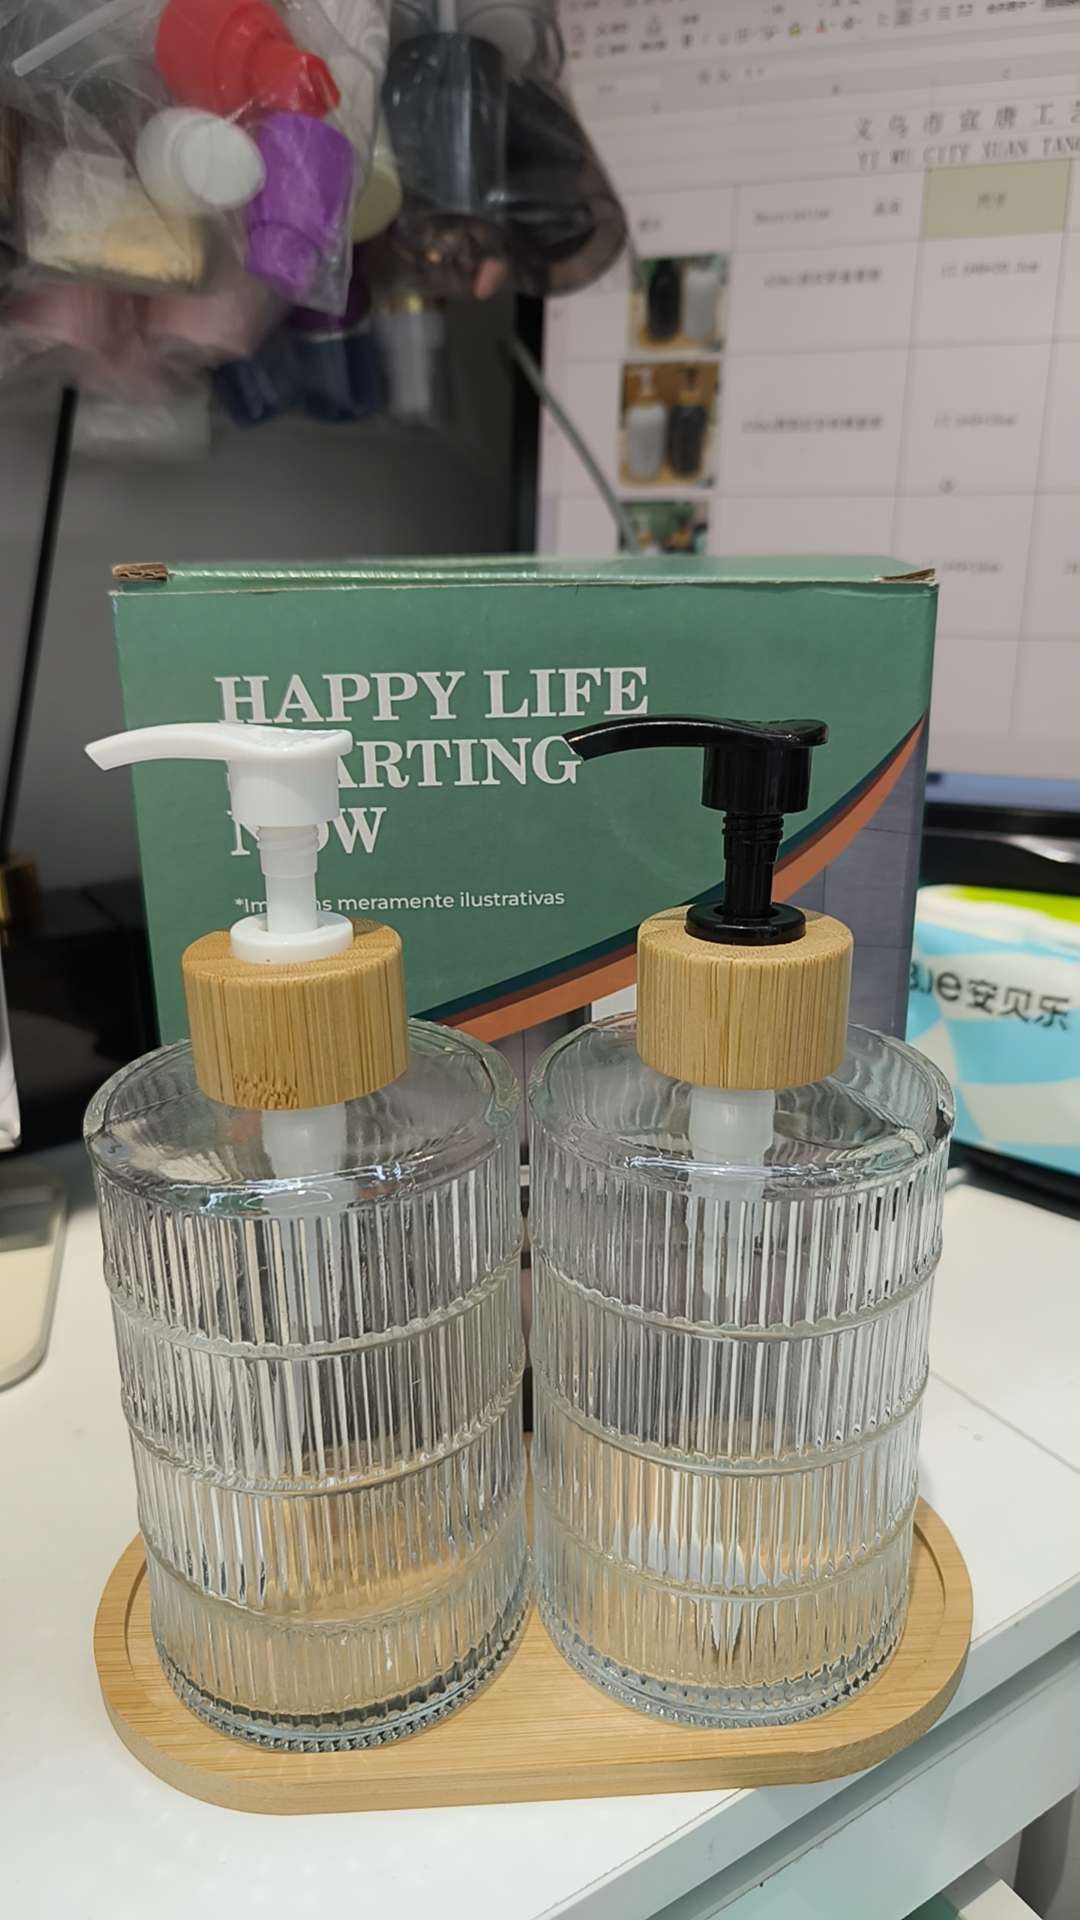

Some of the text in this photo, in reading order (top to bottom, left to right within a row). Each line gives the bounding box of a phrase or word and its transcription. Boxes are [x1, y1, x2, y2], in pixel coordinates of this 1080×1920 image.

[214, 666, 649, 725] HAPPY LIFE
[337, 735, 582, 788] RTING
[338, 892, 455, 912] meramente
[459, 888, 566, 909] ilustrativas
